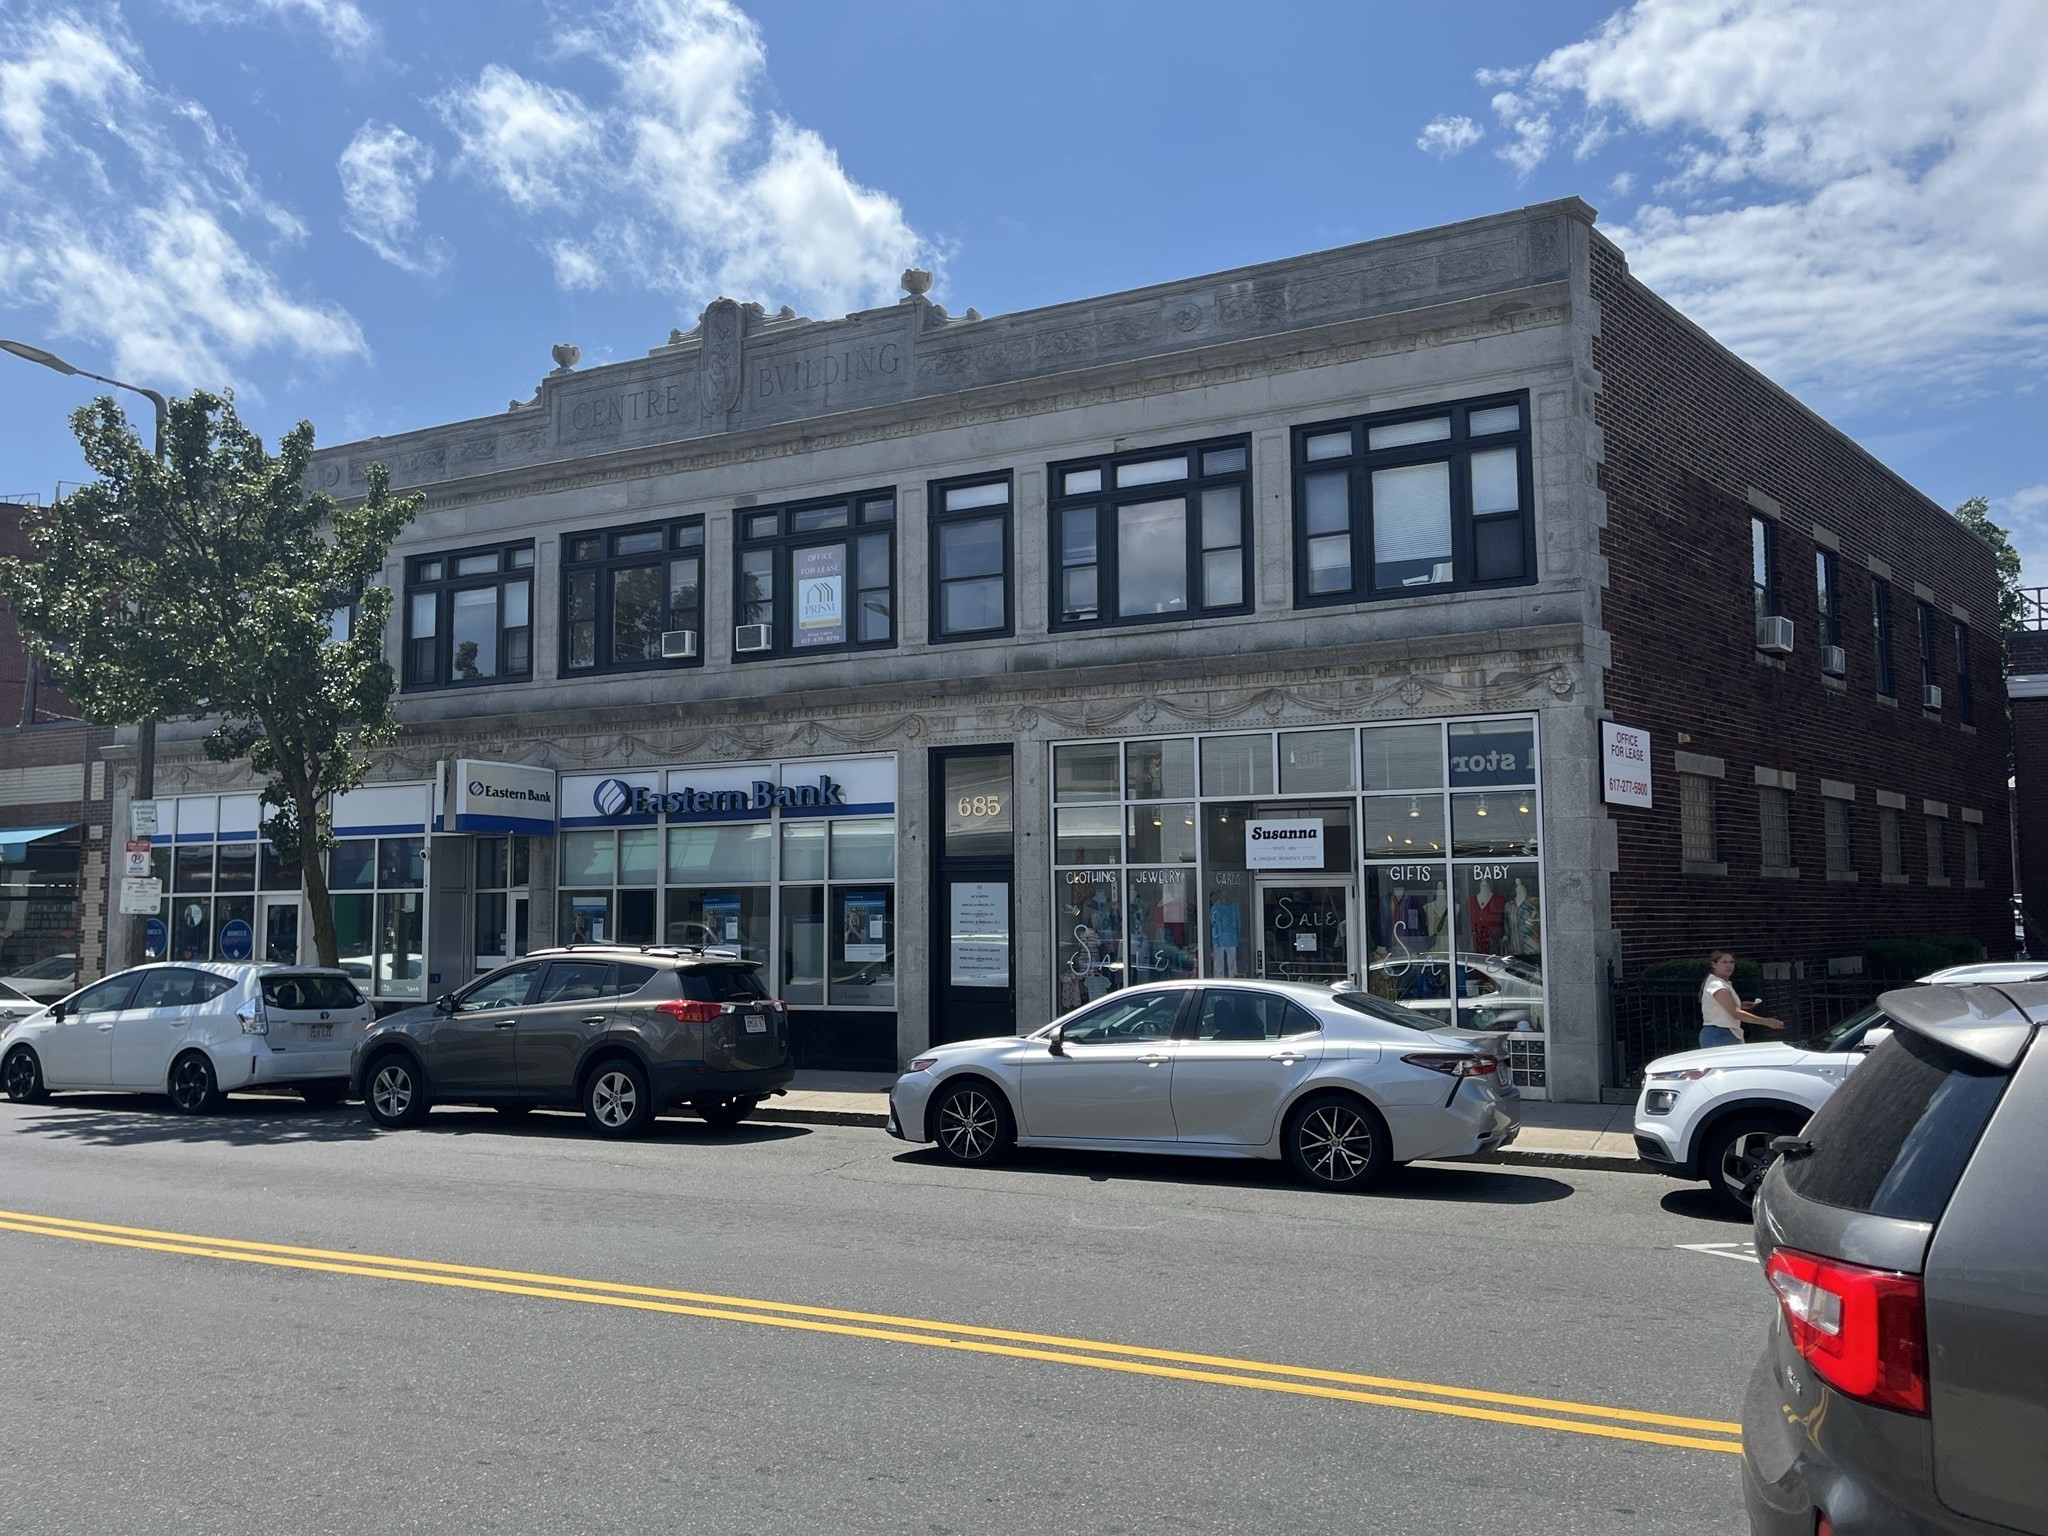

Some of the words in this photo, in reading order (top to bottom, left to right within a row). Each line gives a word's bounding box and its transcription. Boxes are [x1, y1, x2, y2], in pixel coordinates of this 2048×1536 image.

[573, 384, 679, 431] CENTRE
[807, 551, 833, 562] OFFICE
[800, 567, 816, 576] FOR
[817, 564, 840, 574] LEASE
[805, 602, 835, 616] PRISM
[1616, 731, 1639, 747] OFFICE
[1611, 744, 1625, 758] FOR
[1625, 746, 1644, 762] LEASE
[485, 785, 527, 800] Eastern
[528, 789, 552, 803] Bank
[631, 786, 749, 815] Eastern
[752, 774, 842, 809] Bank
[1609, 777, 1648, 796] 617-277-5900
[957, 795, 1002, 817] 685
[1252, 826, 1318, 841] Susanna
[1066, 871, 1116, 885] CLOTHING
[1136, 870, 1182, 884] JEWELRY
[1215, 872, 1241, 886] CARDS
[1390, 865, 1432, 882] GIFTS
[1473, 865, 1511, 881] BABY
[1275, 897, 1336, 929] SALE
